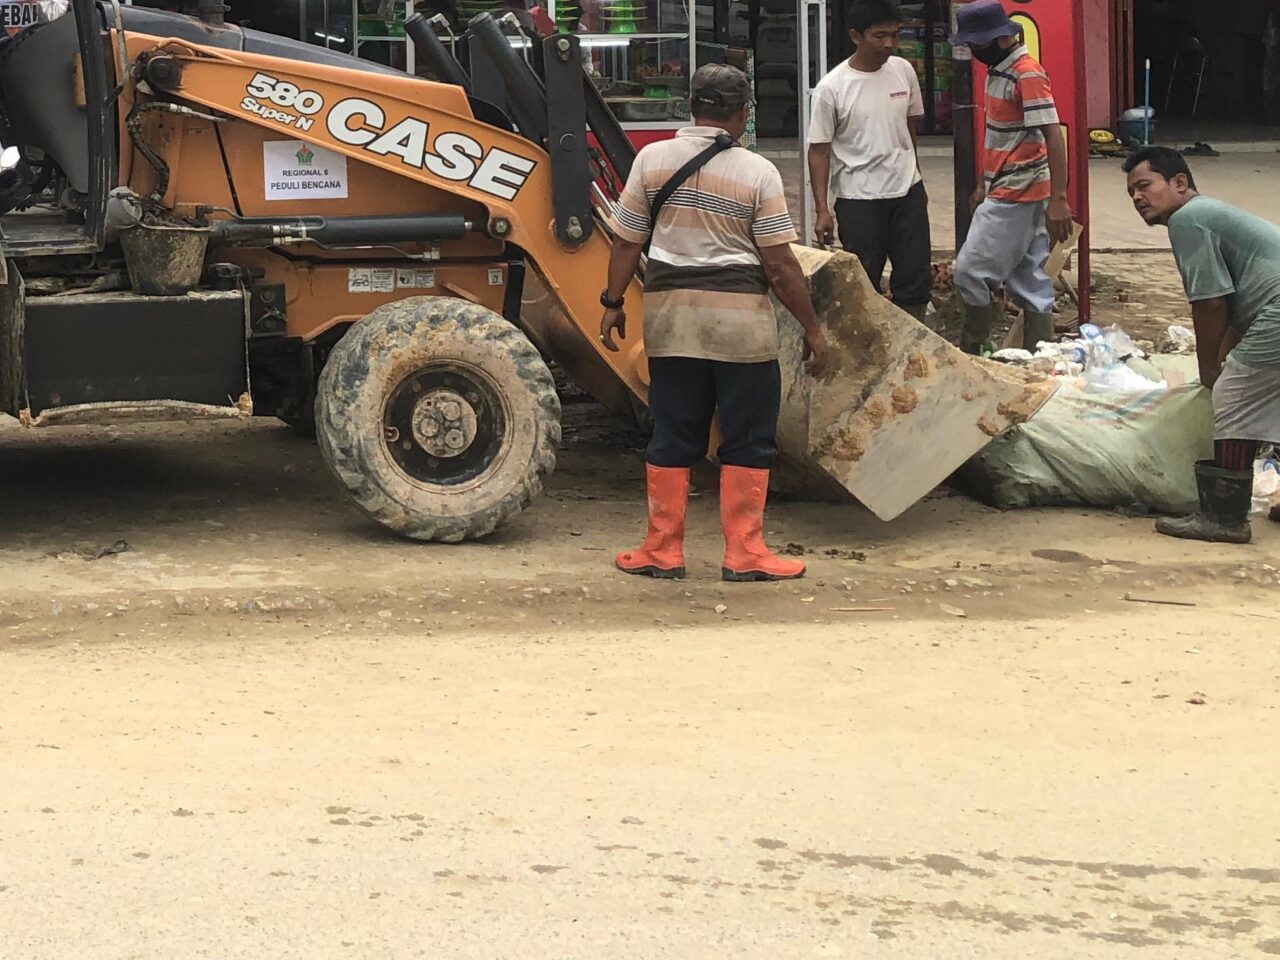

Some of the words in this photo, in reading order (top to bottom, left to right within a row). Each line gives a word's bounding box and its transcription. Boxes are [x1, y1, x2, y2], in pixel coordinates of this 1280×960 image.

[246, 72, 324, 116] 580
[240, 96, 297, 125] Super
[294, 115, 316, 132] N
[326, 97, 538, 201] CASE
[270, 181, 300, 190] PEDULI
[301, 180, 341, 190] BENCANA
[282, 169, 323, 177] REGIONAL
